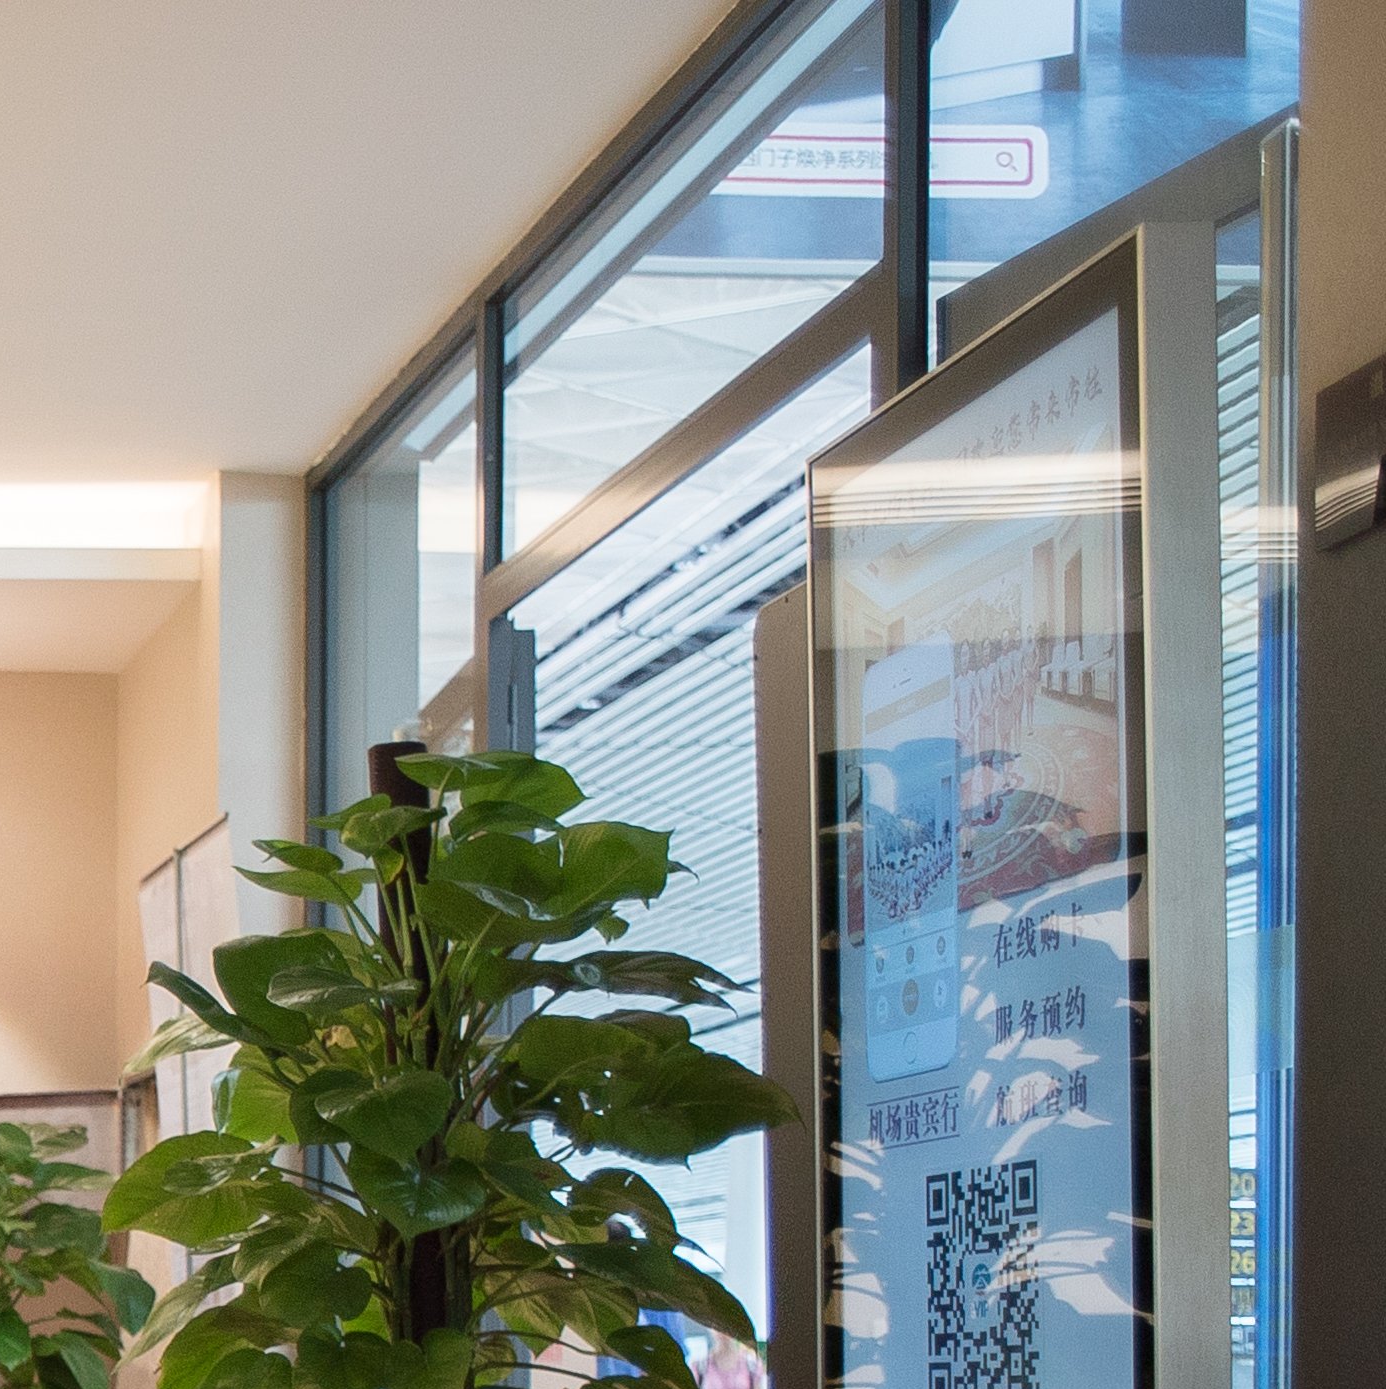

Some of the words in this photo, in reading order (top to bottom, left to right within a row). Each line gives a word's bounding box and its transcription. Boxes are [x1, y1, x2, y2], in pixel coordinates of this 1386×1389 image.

[993, 901, 1084, 970] 在线购卡
[994, 984, 1087, 1046] 服务预约
[869, 1092, 959, 1147] 机场贵宾行
[995, 1069, 1088, 1128] 航班查询
